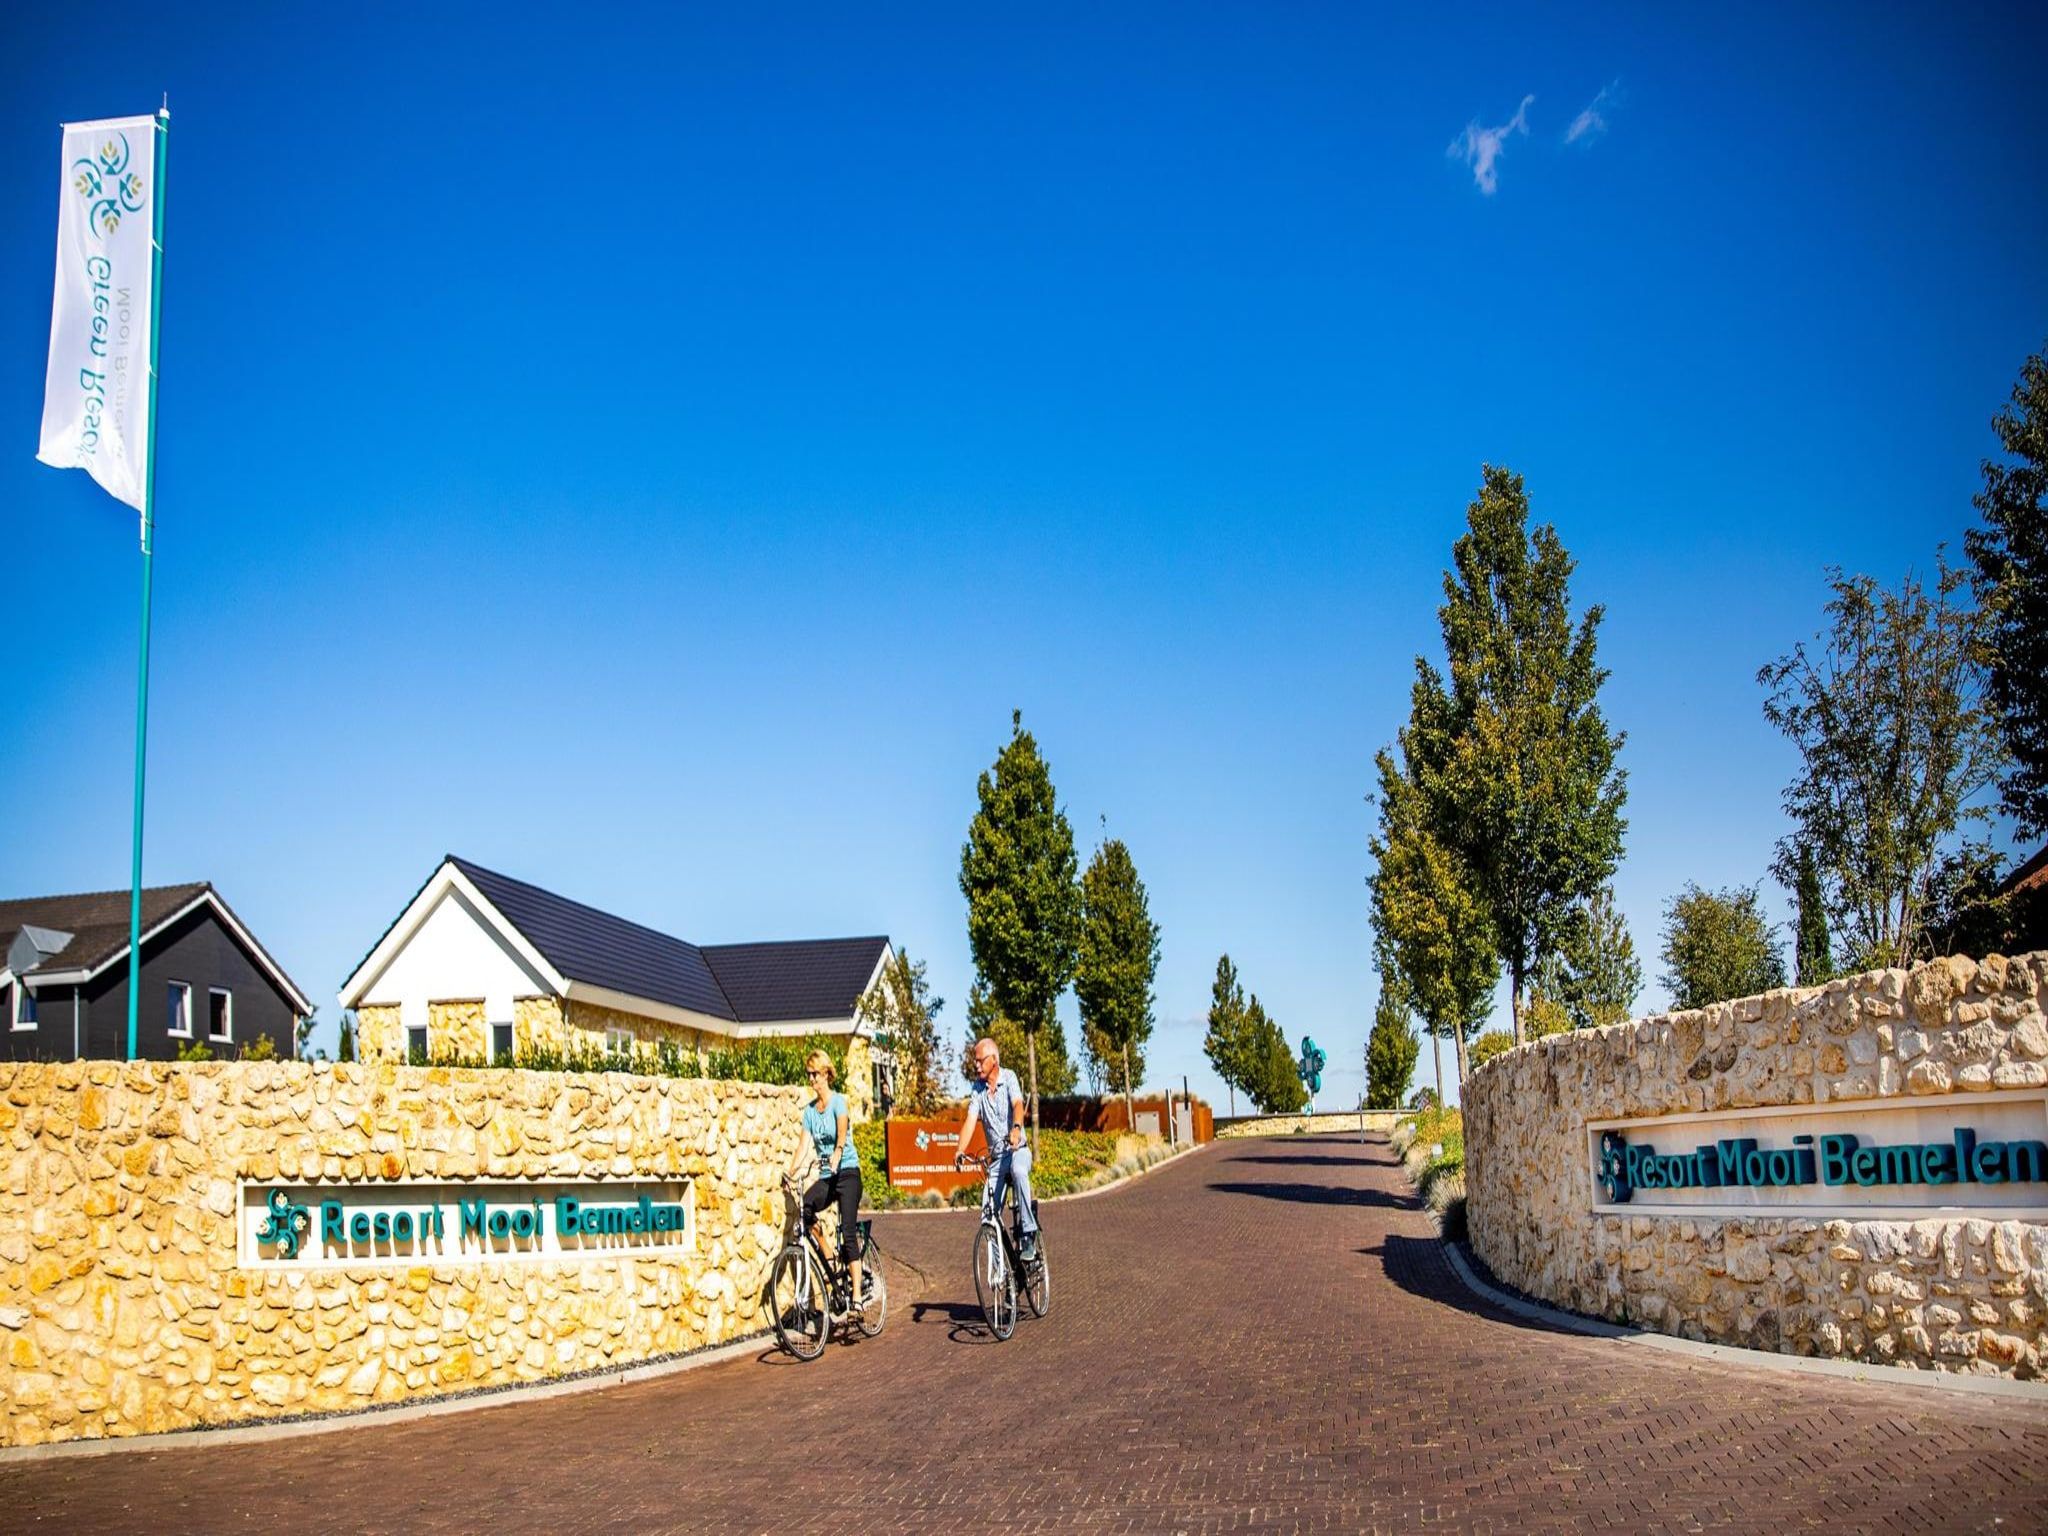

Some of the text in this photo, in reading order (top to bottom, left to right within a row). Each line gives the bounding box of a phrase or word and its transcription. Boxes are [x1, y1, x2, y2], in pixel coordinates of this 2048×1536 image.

[1626, 1127, 2047, 1189] Resort Mooi Bemelen
[320, 1195, 686, 1244] Resort Mooi Bemelen
